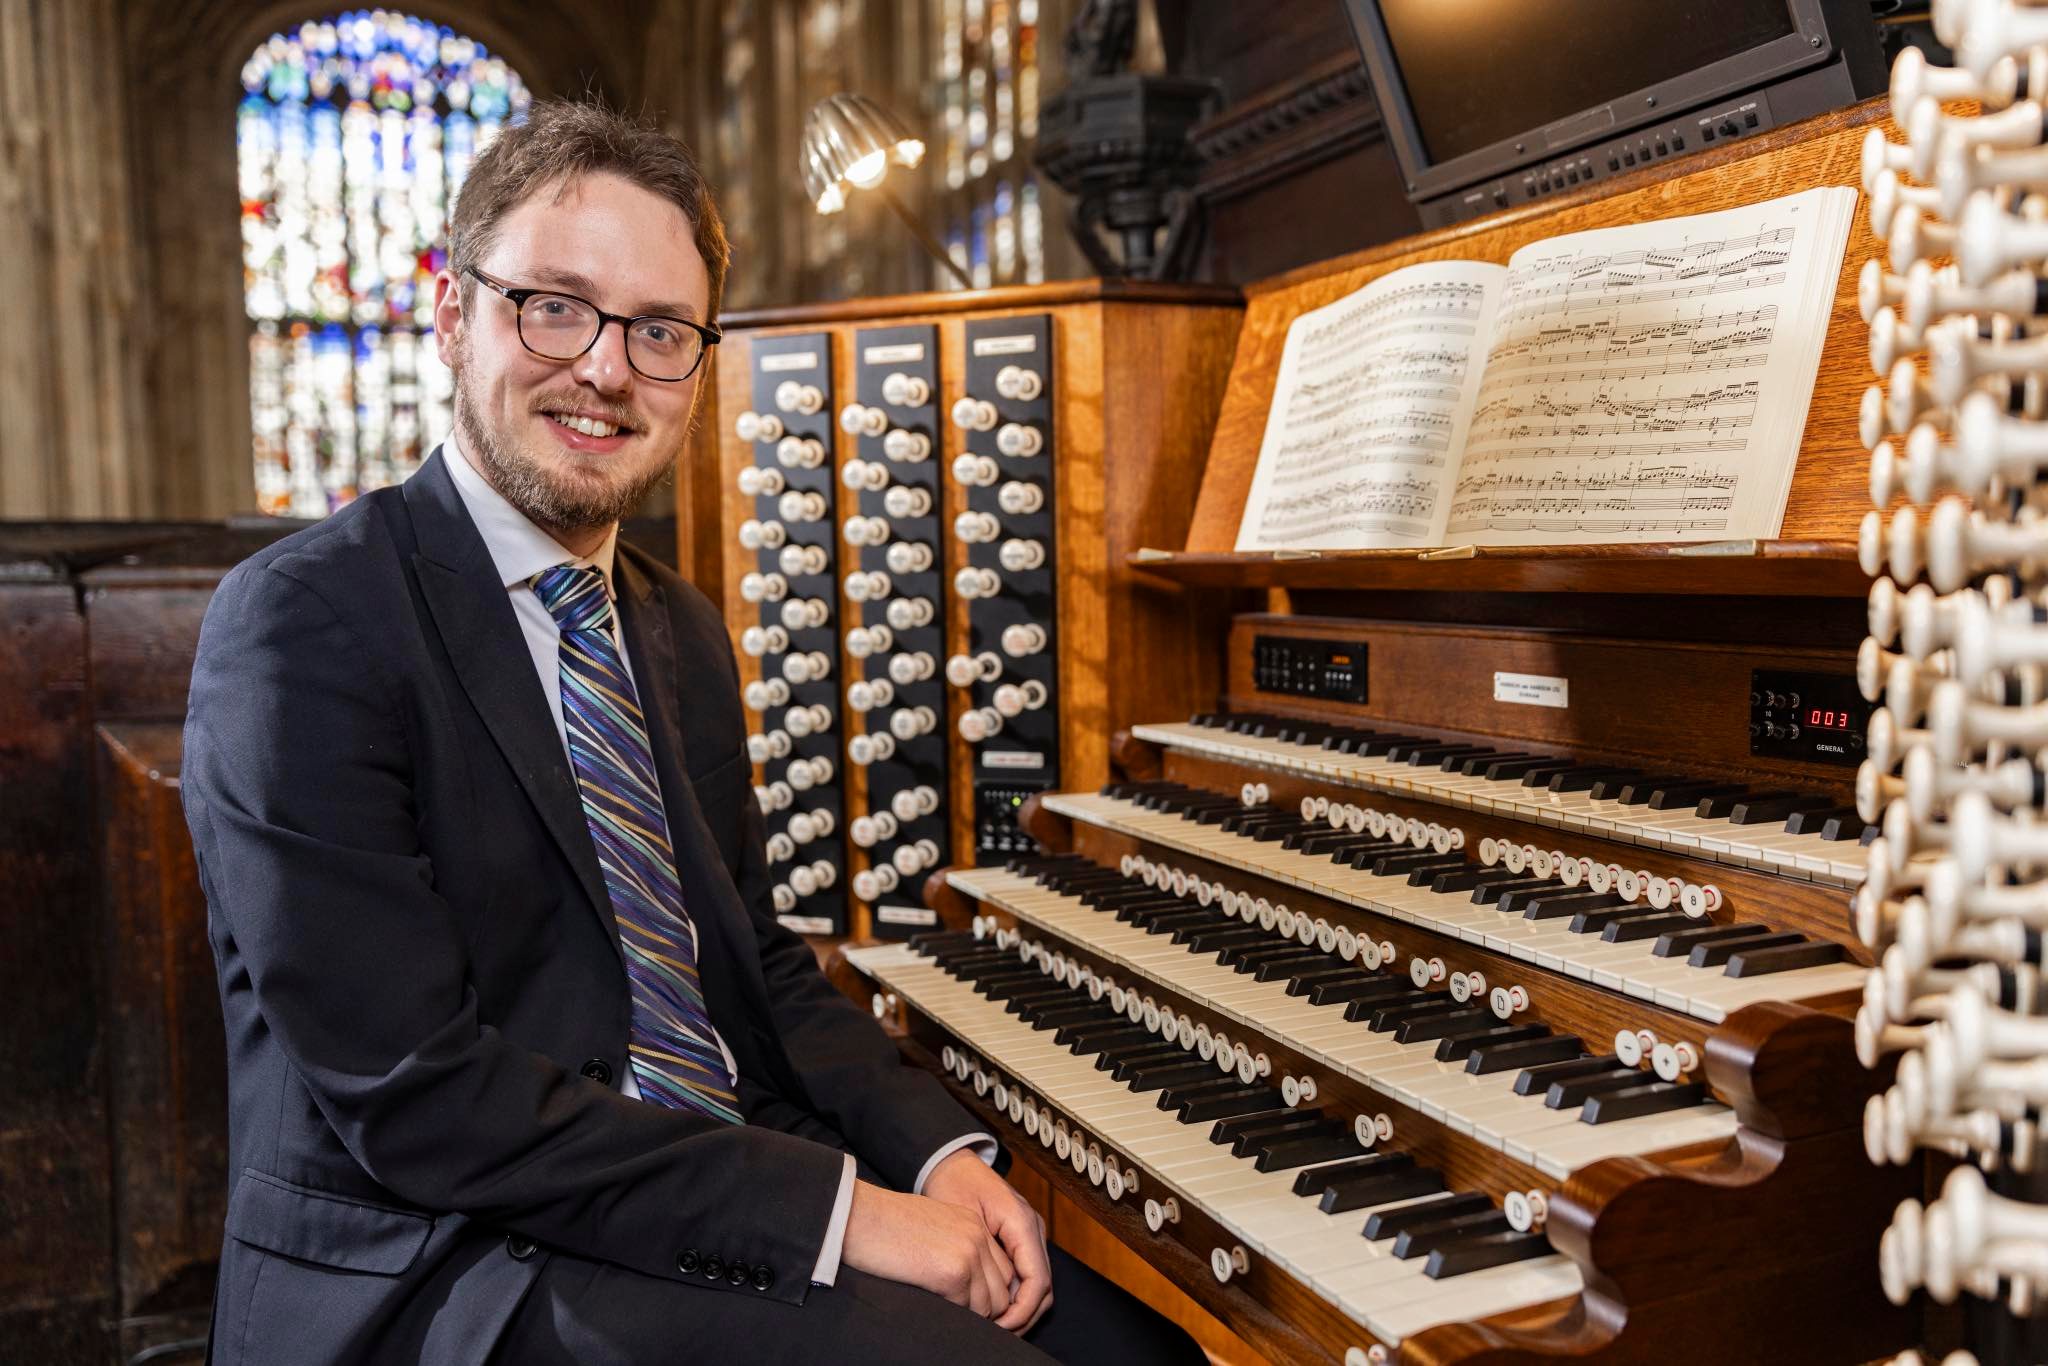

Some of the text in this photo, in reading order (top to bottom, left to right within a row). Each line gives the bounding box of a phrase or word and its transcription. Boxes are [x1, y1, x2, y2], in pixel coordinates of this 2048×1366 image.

[1811, 711, 1847, 727] 003
[1816, 744, 1845, 754] GENERAL
[1512, 854, 1518, 864] 2
[1539, 859, 1545, 869] 3
[1567, 866, 1574, 876] 4
[1596, 873, 1603, 883] 5
[1625, 880, 1632, 890] 6
[1656, 887, 1662, 898] 7
[1690, 895, 1697, 906] 8
